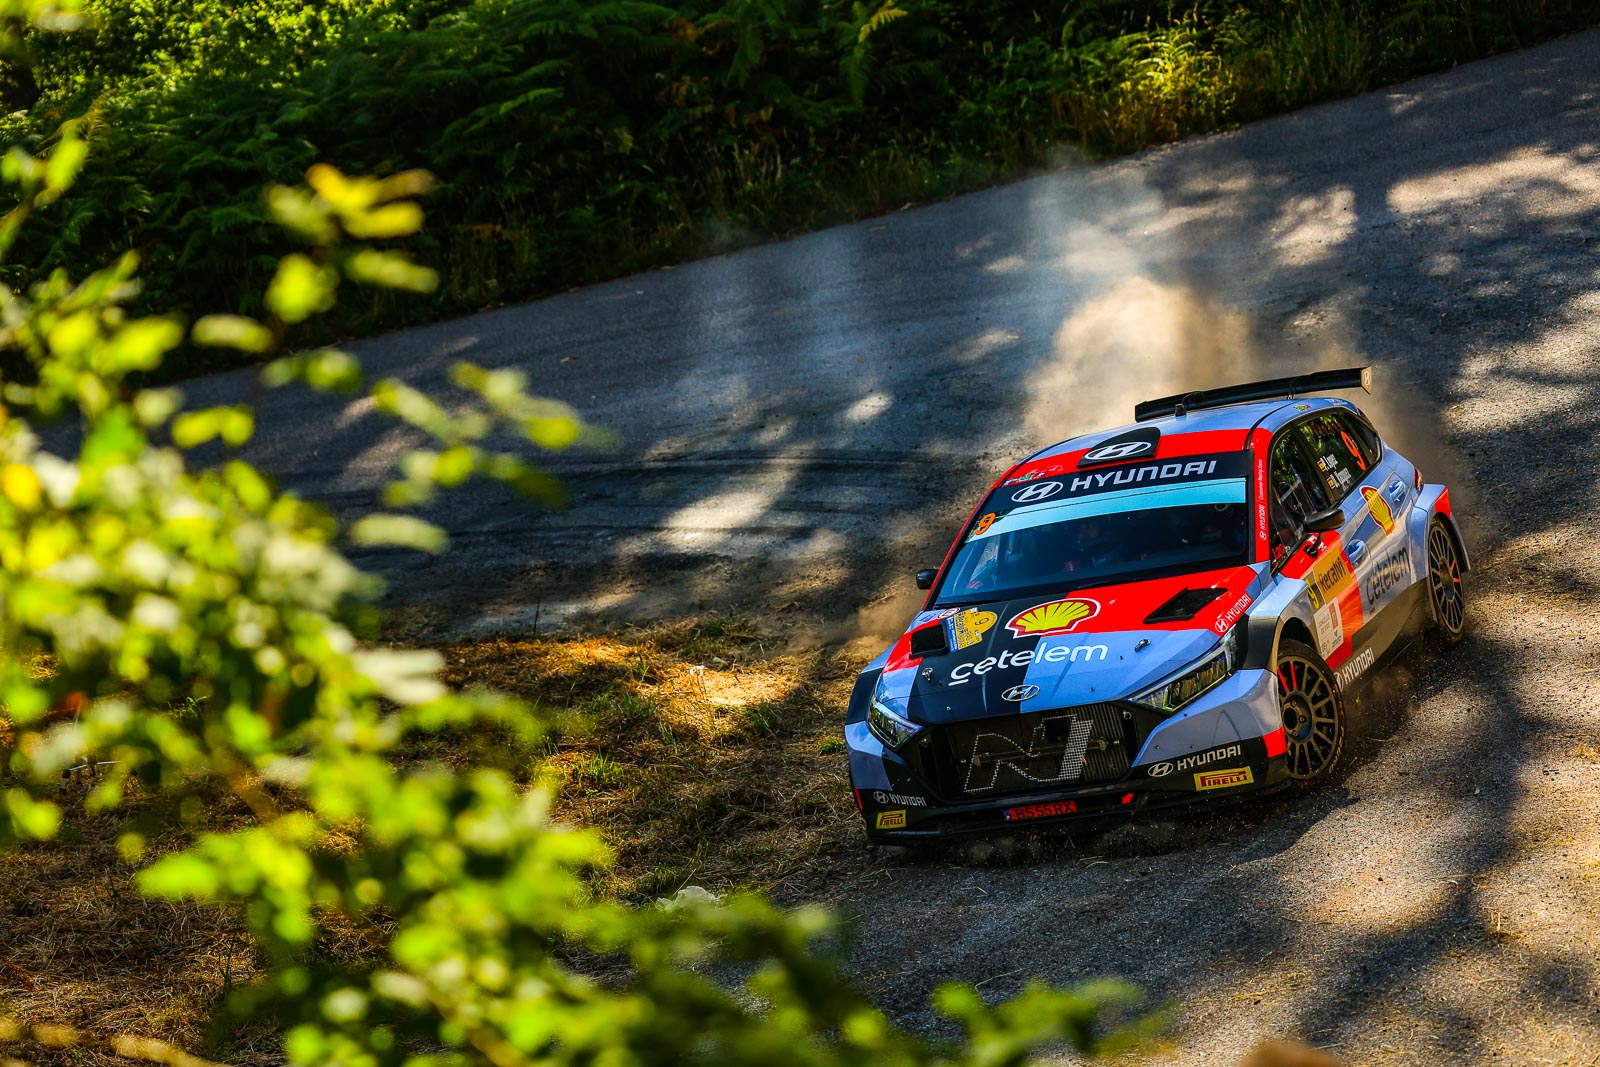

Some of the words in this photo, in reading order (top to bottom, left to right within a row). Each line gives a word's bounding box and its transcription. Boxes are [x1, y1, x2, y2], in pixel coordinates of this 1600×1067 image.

[1341, 431, 1366, 470] 9
[1070, 460, 1217, 492] HYUNDAI
[974, 512, 996, 535] 9
[1318, 557, 1346, 593] Recalvi
[1366, 547, 1411, 606] cetelem
[1225, 593, 1251, 622] HYUNDAI
[949, 642, 1109, 682] cetelem
[1342, 647, 1375, 685] HYUNDAI
[1177, 744, 1242, 771] HYUNDAI
[1200, 770, 1248, 787] PIRELLI
[889, 793, 927, 807] HYUNDAI
[880, 813, 903, 826] PIRELLI
